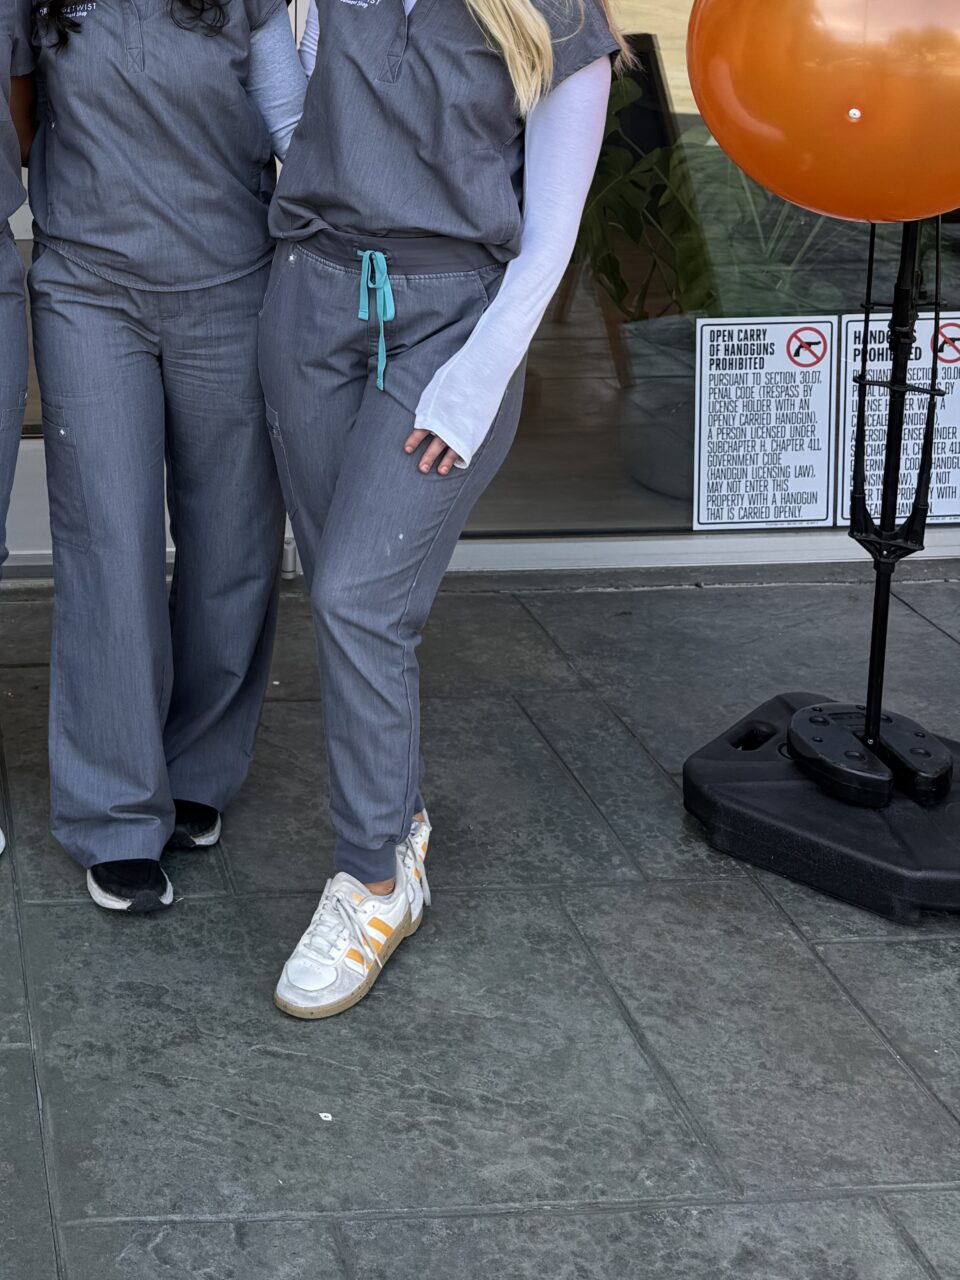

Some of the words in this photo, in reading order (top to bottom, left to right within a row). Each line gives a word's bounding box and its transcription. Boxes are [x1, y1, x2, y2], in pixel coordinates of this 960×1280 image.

[710, 330, 733, 343] OPEN
[737, 329, 767, 342] CARRY
[709, 344, 721, 357] OF
[724, 343, 775, 356] HANDGUNS
[709, 357, 764, 371] PROHIBITED
[709, 373, 748, 386] PURSUANT
[752, 373, 761, 385] TO
[765, 372, 796, 385] SECTION
[907, 368, 938, 381] SECTIO
[942, 367, 960, 380] 30.0
[709, 386, 732, 400] PENAL
[736, 386, 755, 399] CODE
[759, 385, 799, 399] (TRESPASS
[803, 385, 813, 397] BY
[945, 381, 955, 395] BY
[708, 400, 738, 413] LICENSE
[743, 400, 771, 412] HOLDER
[775, 399, 795, 411] WITH
[800, 399, 810, 411] AN
[940, 397, 946, 410] A
[708, 414, 736, 427] OPENLY
[740, 413, 771, 426] CARRIED
[708, 428, 712, 440] A
[717, 427, 746, 440] PERSON
[751, 426, 786, 439] LICENSED
[790, 425, 815, 437] UNDER
[708, 440, 756, 453] SUBCHAPTER
[771, 439, 804, 452] CHAPTER
[708, 453, 759, 467] GOVERNMENT
[763, 453, 781, 465] CODE
[707, 467, 747, 480] (HANDGUN
[752, 466, 790, 479] LICENSING
[936, 471, 951, 485] NOT
[707, 481, 723, 493] MAY
[727, 480, 741, 493] NOT
[745, 480, 768, 493] ENTER
[773, 479, 788, 492] THIS
[937, 486, 957, 499] WITH
[707, 494, 744, 507] PROPERTY
[748, 493, 768, 505] WITH
[771, 493, 776, 505] A
[781, 492, 817, 504] HANDGUN
[707, 507, 723, 520] THAT
[728, 507, 734, 520] IS
[739, 506, 770, 519] CARRIED
